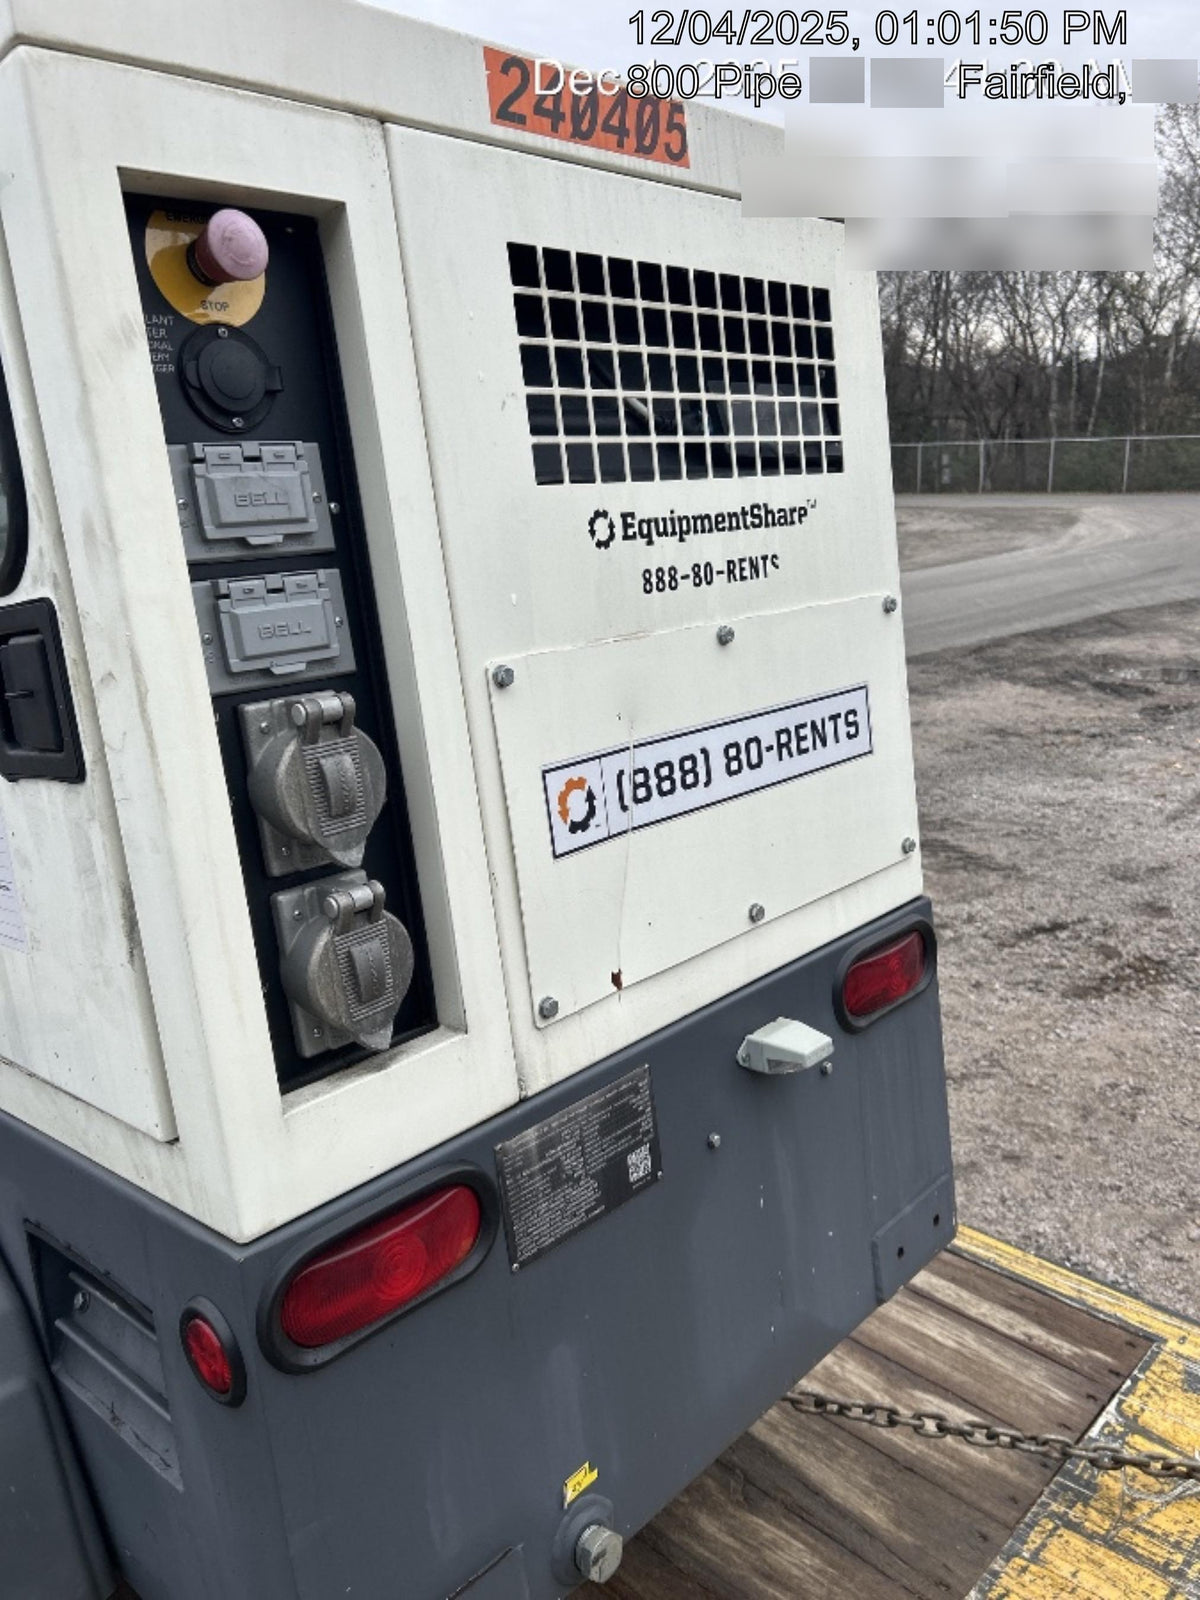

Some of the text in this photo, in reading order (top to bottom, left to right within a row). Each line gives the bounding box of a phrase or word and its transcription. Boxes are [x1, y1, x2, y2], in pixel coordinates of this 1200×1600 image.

[495, 56, 689, 162] 240405
[201, 301, 230, 312] STOP
[234, 490, 289, 507] BELL
[257, 621, 312, 639] BELL
[616, 708, 860, 812] (888) 80-RENTS
